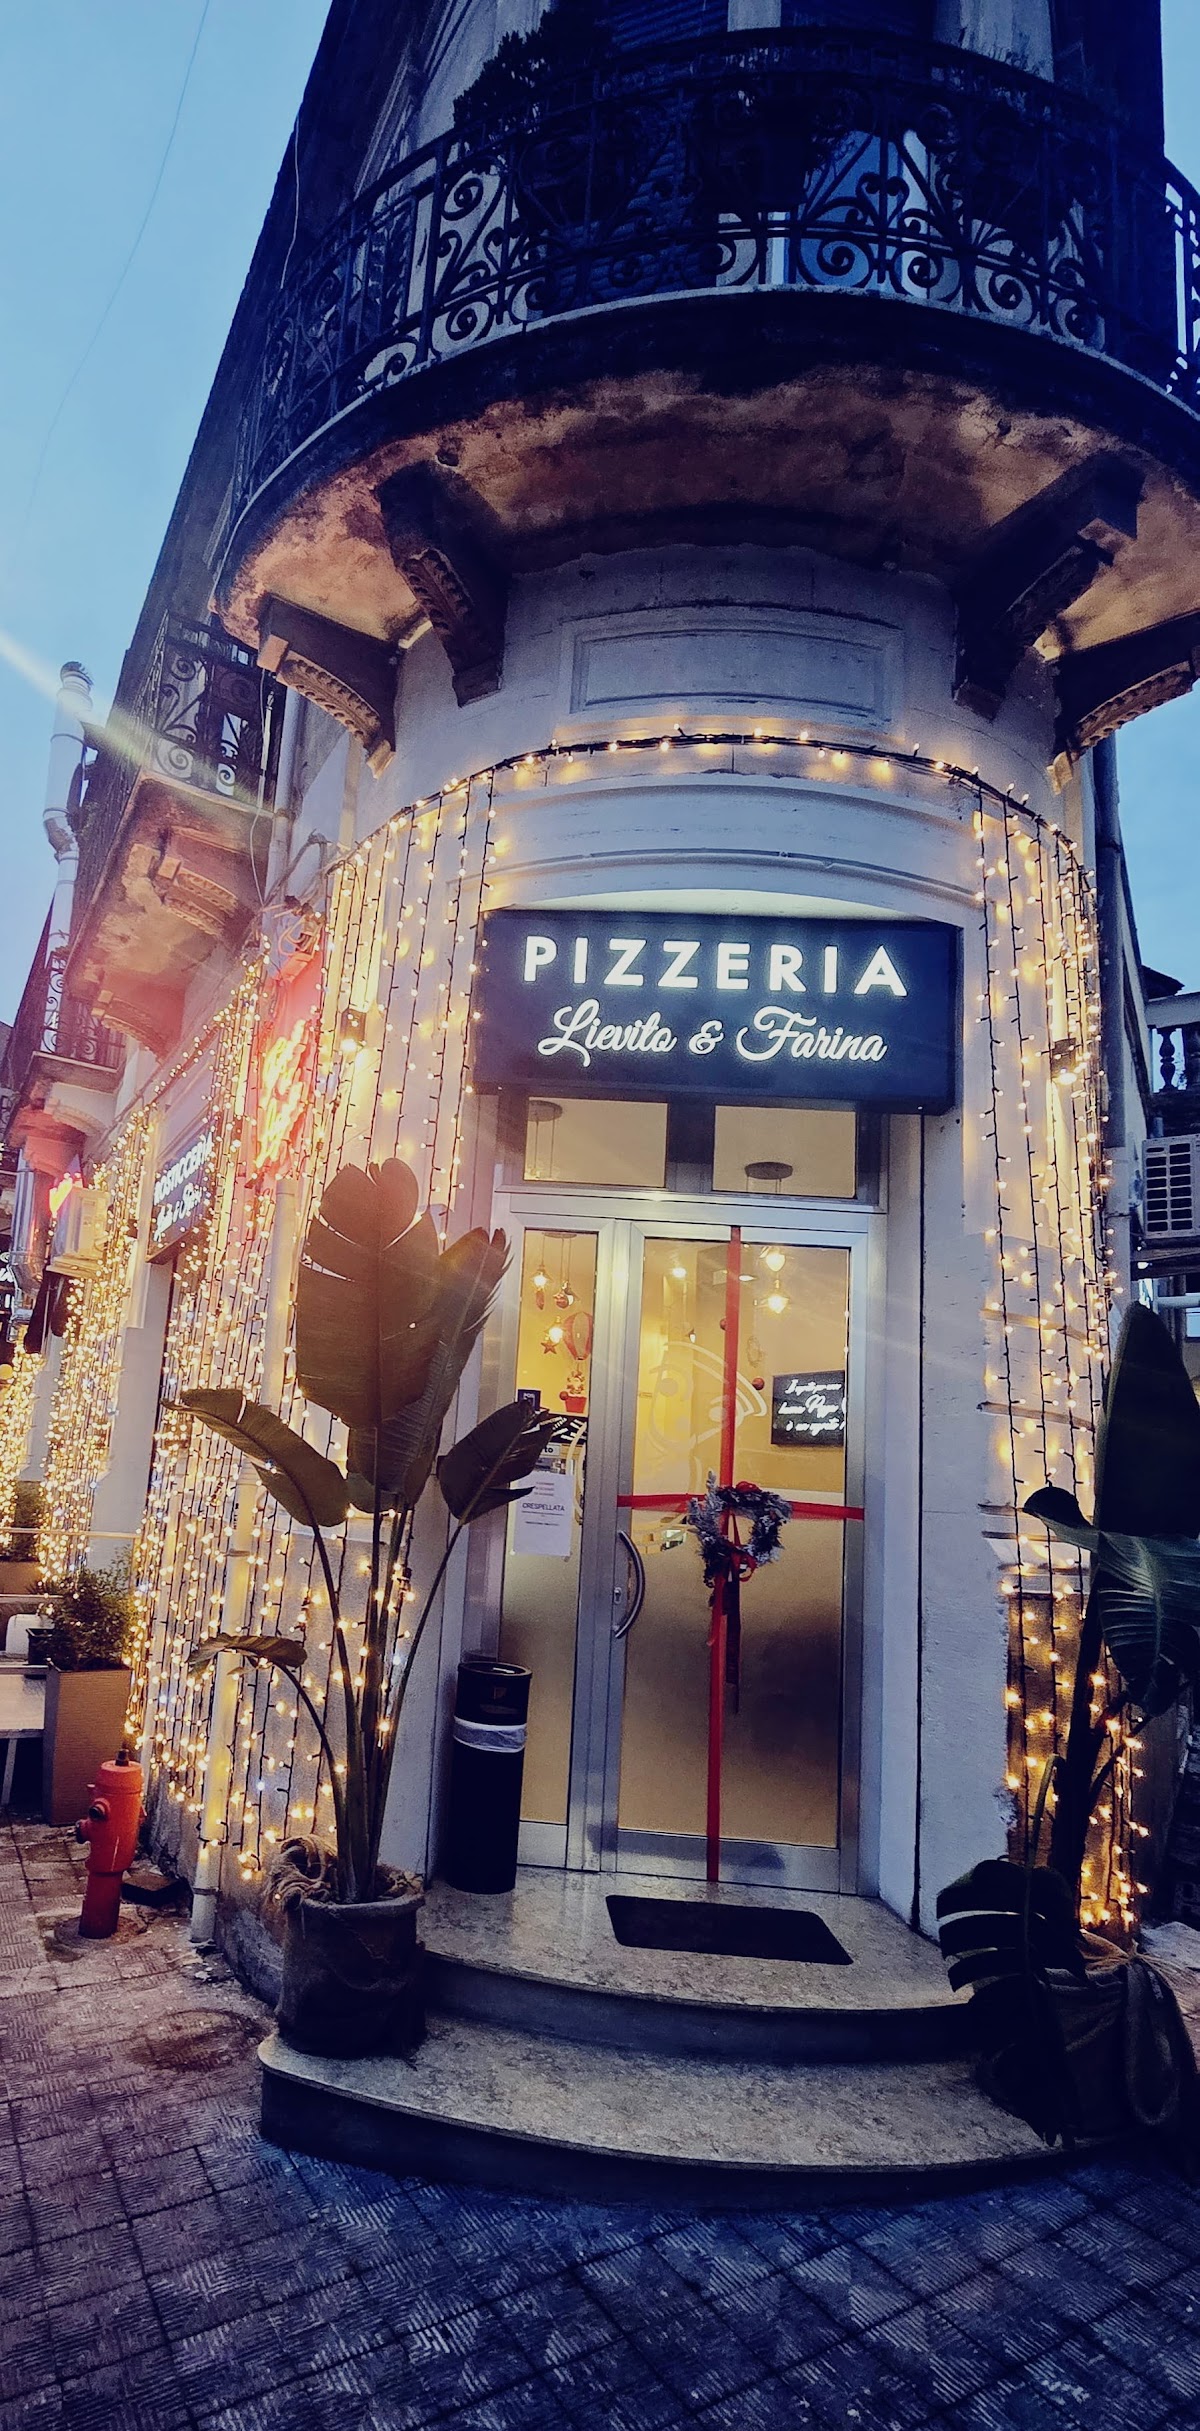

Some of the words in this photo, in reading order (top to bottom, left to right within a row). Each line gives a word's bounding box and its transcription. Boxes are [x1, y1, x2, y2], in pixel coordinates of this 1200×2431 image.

[523, 935, 908, 998] PIZZERIA
[537, 998, 678, 1067] Lievito
[688, 1020, 725, 1056] &
[737, 1005, 889, 1062] Farina
